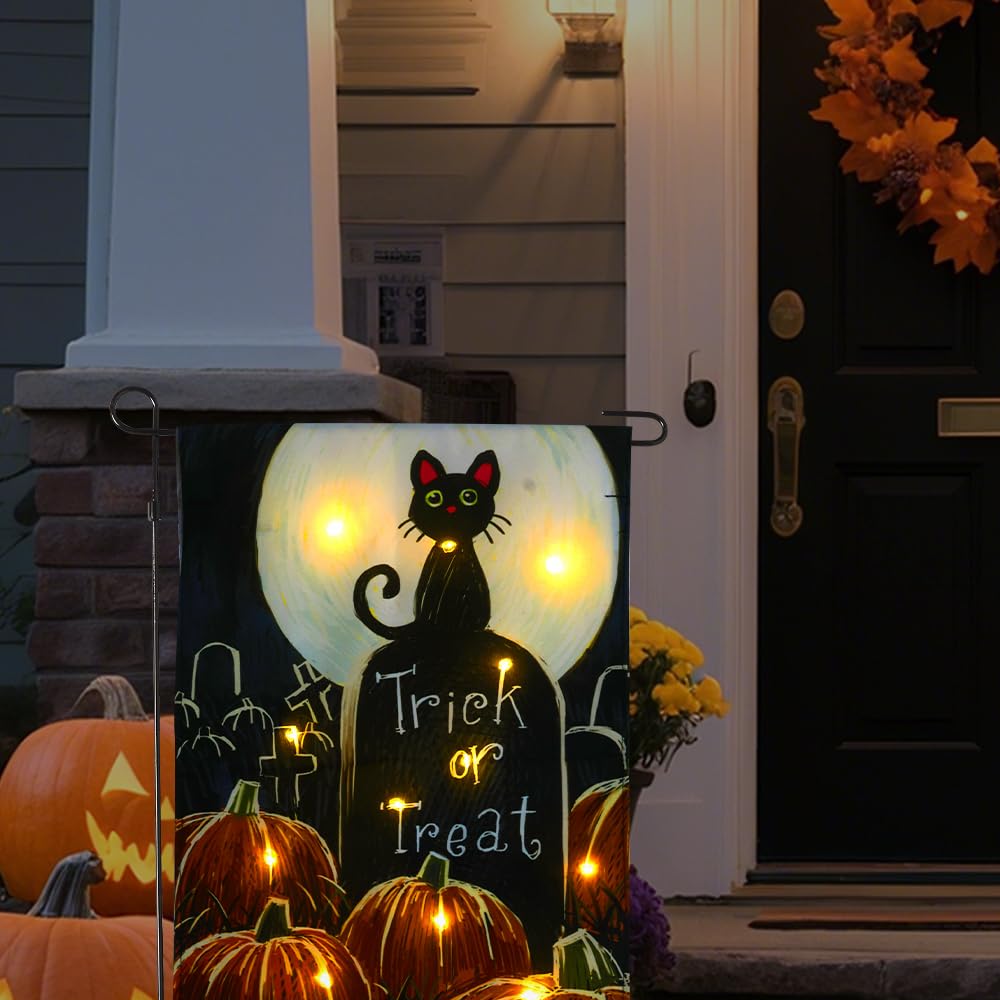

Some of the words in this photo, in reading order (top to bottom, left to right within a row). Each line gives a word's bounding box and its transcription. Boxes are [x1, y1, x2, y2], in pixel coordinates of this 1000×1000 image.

[376, 658, 527, 734] Trick
[450, 743, 504, 785] or
[380, 796, 542, 860] Treat
